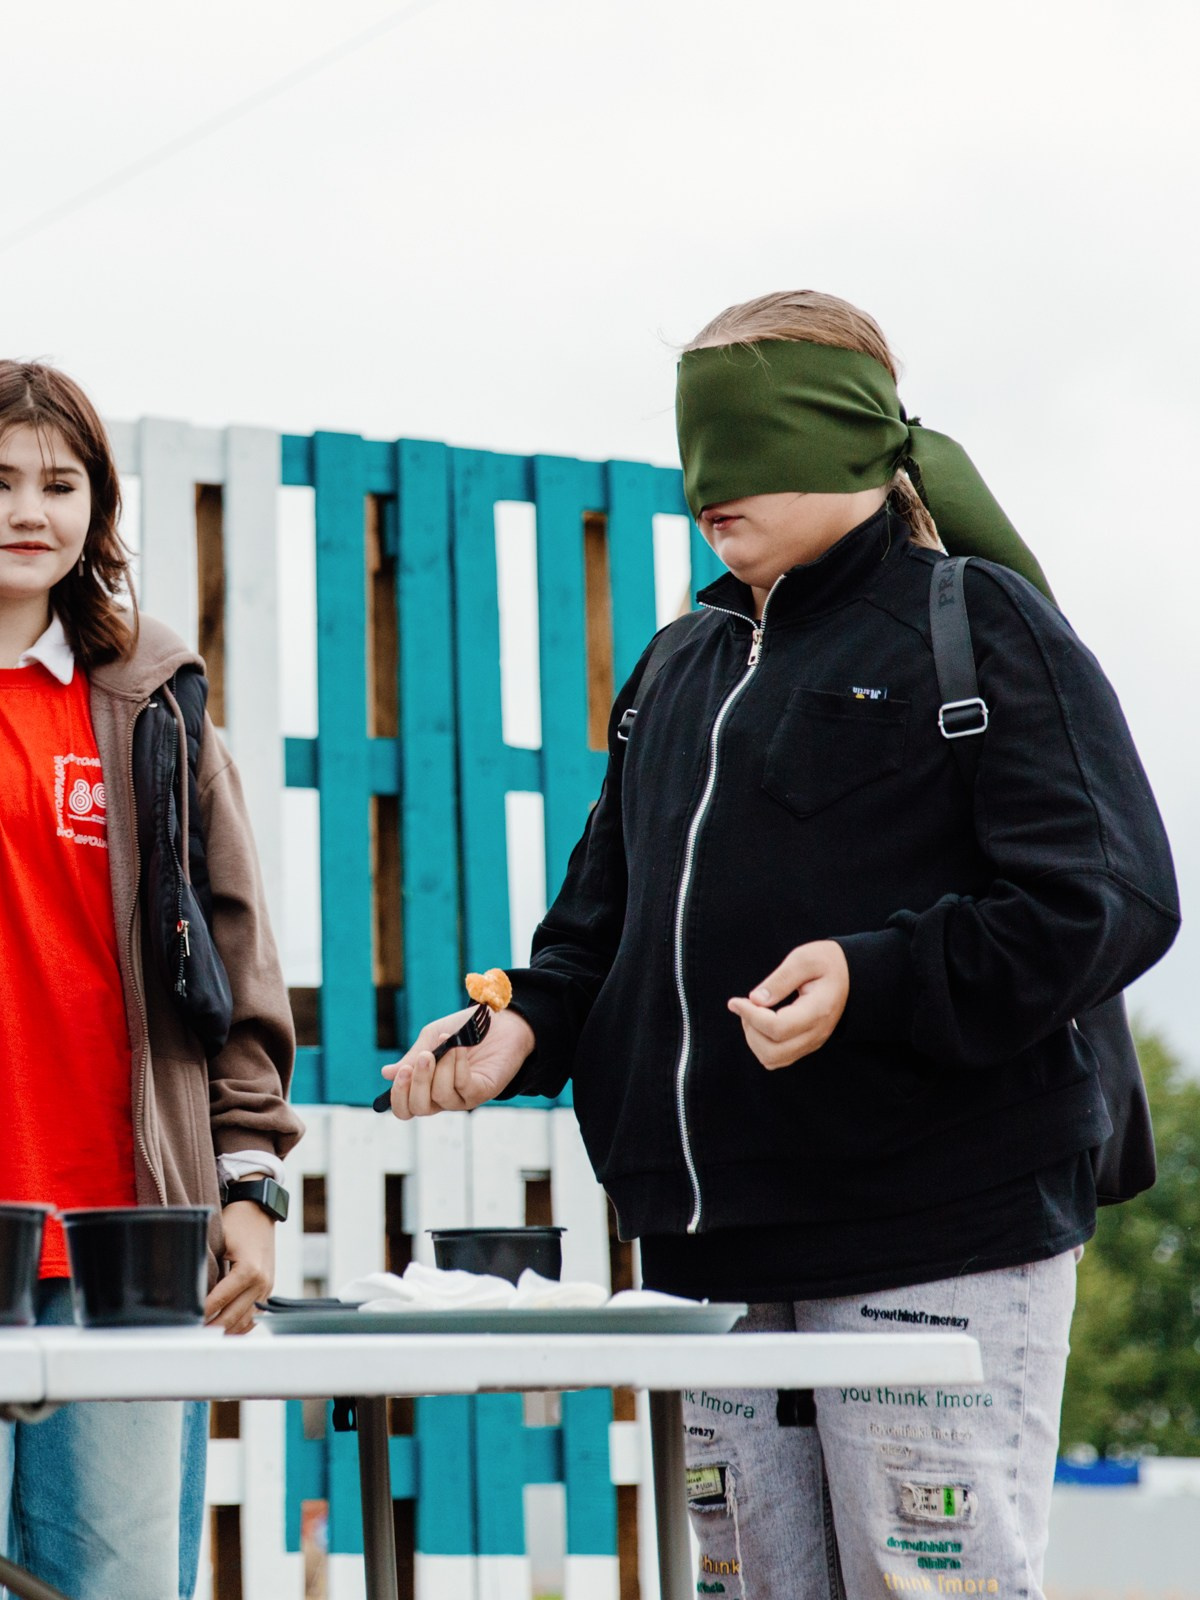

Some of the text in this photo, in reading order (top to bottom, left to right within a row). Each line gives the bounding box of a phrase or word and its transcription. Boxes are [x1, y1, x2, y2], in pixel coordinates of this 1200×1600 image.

[839, 1387, 871, 1404] you
[877, 1387, 928, 1407] think
[702, 1555, 739, 1575] hink
